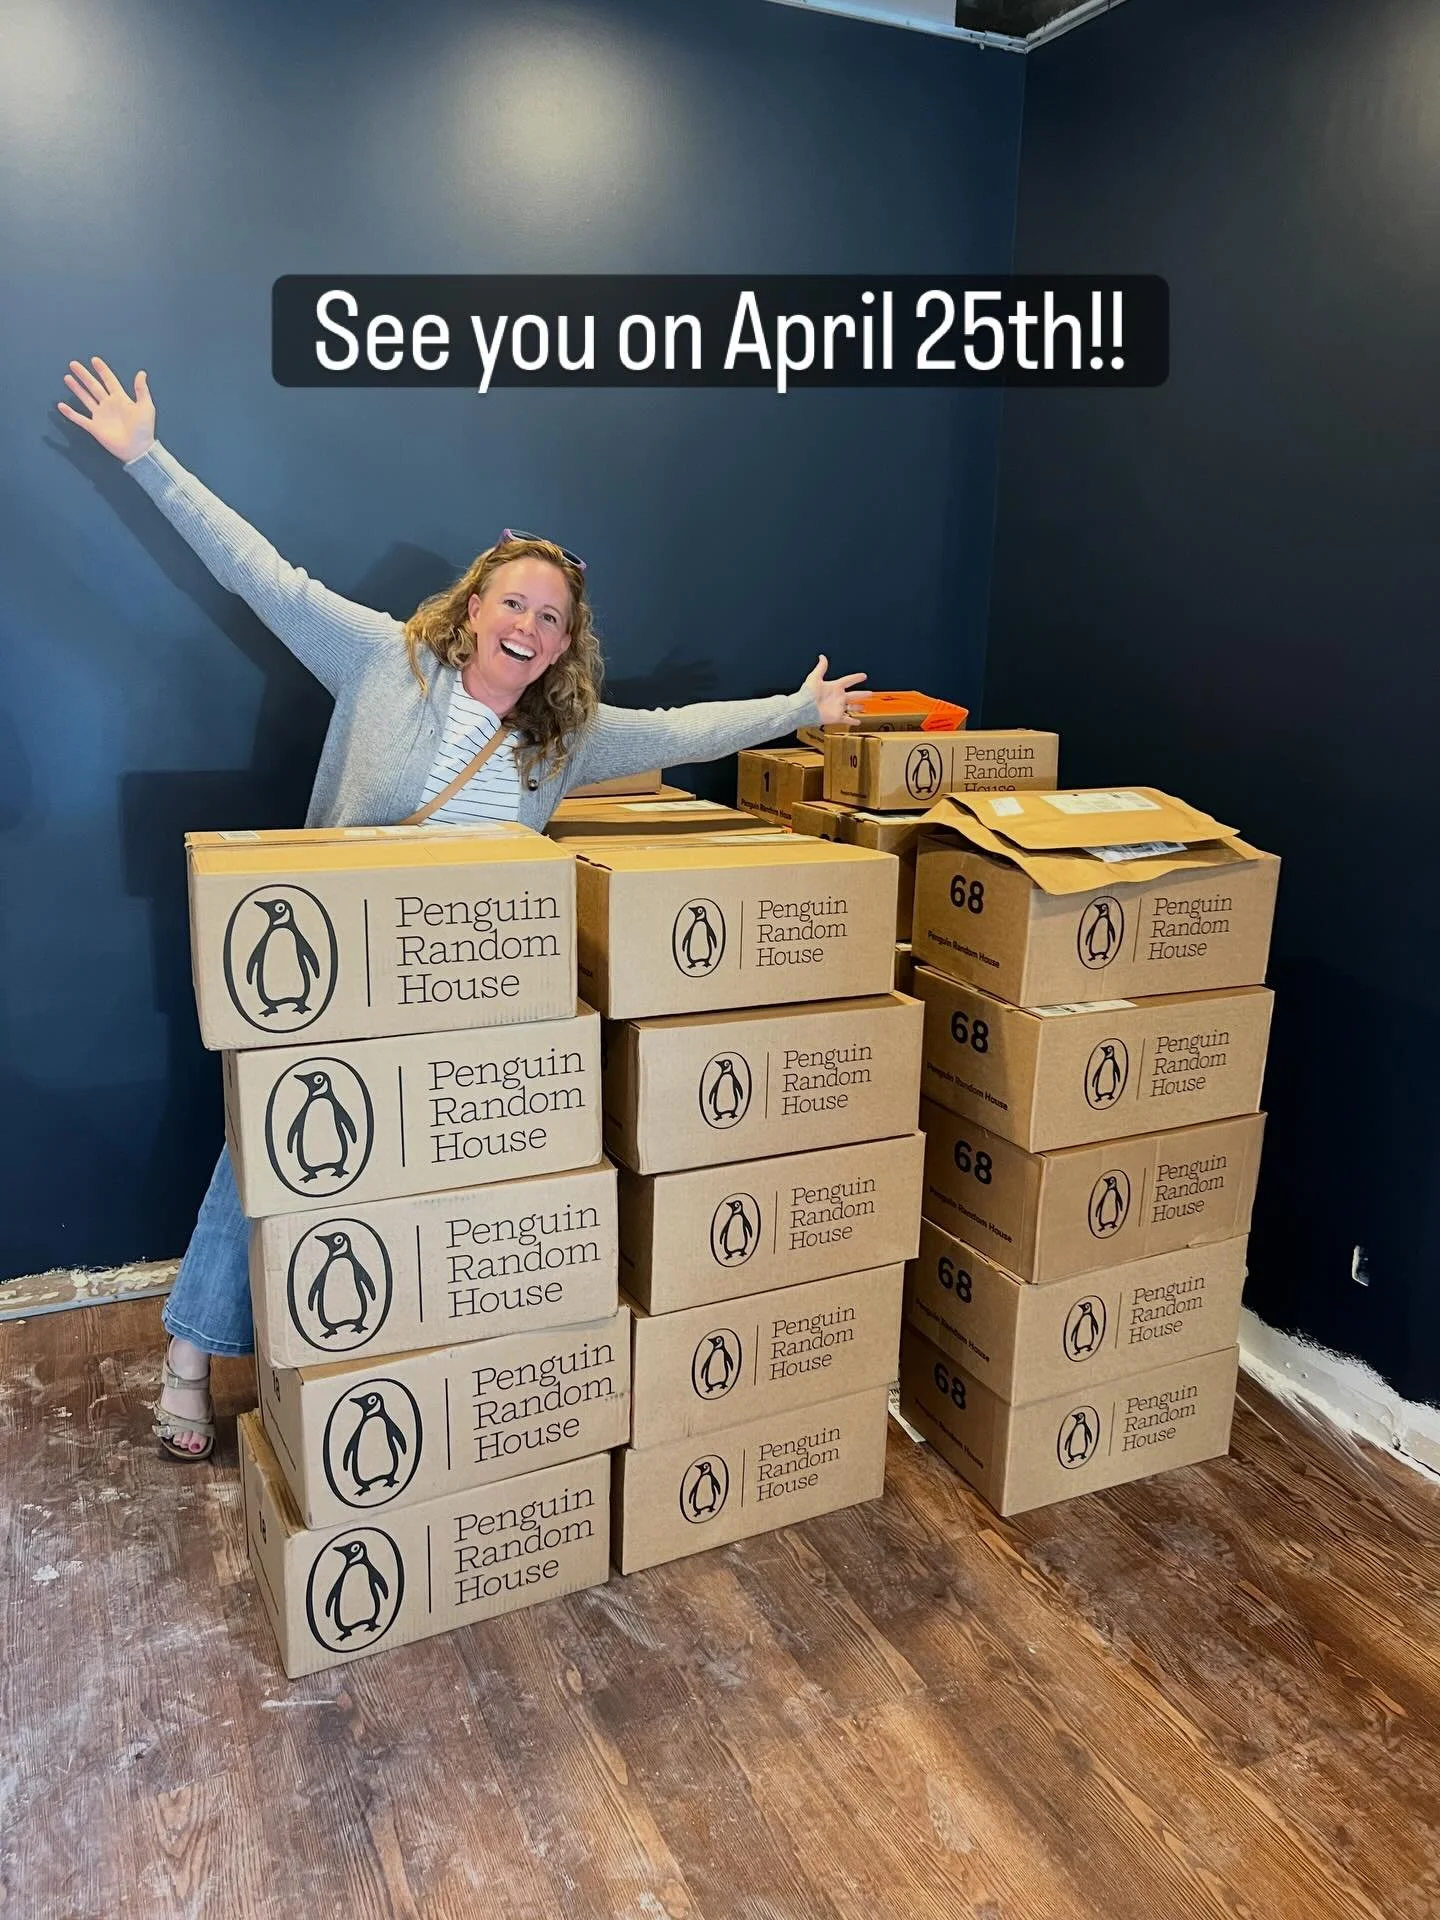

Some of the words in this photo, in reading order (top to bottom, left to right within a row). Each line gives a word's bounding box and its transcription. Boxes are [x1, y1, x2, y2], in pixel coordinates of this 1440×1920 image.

[850, 755, 858, 768] 10
[965, 745, 1034, 763] Penguin
[763, 772, 770, 792] 1
[963, 763, 1034, 780] Random
[757, 895, 848, 921] Penguin
[950, 874, 985, 914] 68
[1152, 894, 1232, 917] Penguin
[395, 890, 560, 932] Penguin
[756, 920, 848, 944] Random
[1150, 916, 1230, 939] Random
[397, 930, 560, 967] Random
[756, 945, 824, 968] House
[928, 929, 952, 949] Penguin
[952, 940, 978, 960] Random
[979, 951, 1000, 969] House
[1148, 940, 1208, 961] House
[398, 974, 520, 1005] House
[951, 1011, 989, 1054] 68
[1155, 1028, 1230, 1057] Penguin
[428, 1047, 585, 1091] Penguin
[783, 1043, 872, 1069] Penguin
[1153, 1049, 1227, 1077] Random
[782, 1066, 872, 1093] Random
[1151, 1072, 1207, 1098] House
[429, 1086, 586, 1127] Random
[781, 1093, 849, 1116] House
[985, 1092, 1008, 1111] House
[430, 1127, 547, 1164] House
[954, 1140, 993, 1185] 68
[1156, 1152, 1228, 1183] Penguin
[791, 1176, 876, 1207] Penguin
[1154, 1172, 1225, 1202] Random
[790, 1201, 874, 1229] Random
[1152, 1197, 1205, 1224] House
[445, 1204, 600, 1249] Penguin
[789, 1223, 853, 1251] House
[989, 1221, 1013, 1244] House
[447, 1241, 600, 1284] Random
[938, 1256, 973, 1304] 68
[1132, 1273, 1205, 1305] Penguin
[448, 1281, 563, 1318] House
[1130, 1294, 1203, 1325] Random
[772, 1305, 856, 1339] Penguin
[1129, 1316, 1183, 1345] House
[770, 1327, 855, 1360] Random
[472, 1343, 615, 1397] Penguin
[769, 1352, 833, 1382] House
[934, 1362, 967, 1410] 68
[1125, 1382, 1198, 1415] Penguin
[473, 1377, 615, 1430] Random
[1124, 1402, 1196, 1434] Random
[474, 1418, 580, 1463] House
[758, 1426, 841, 1462] Penguin
[1122, 1422, 1177, 1453] House
[757, 1446, 840, 1481] Random
[756, 1472, 818, 1504] House
[454, 1488, 595, 1543] Penguin
[455, 1519, 595, 1574] Random
[455, 1560, 560, 1606] House
